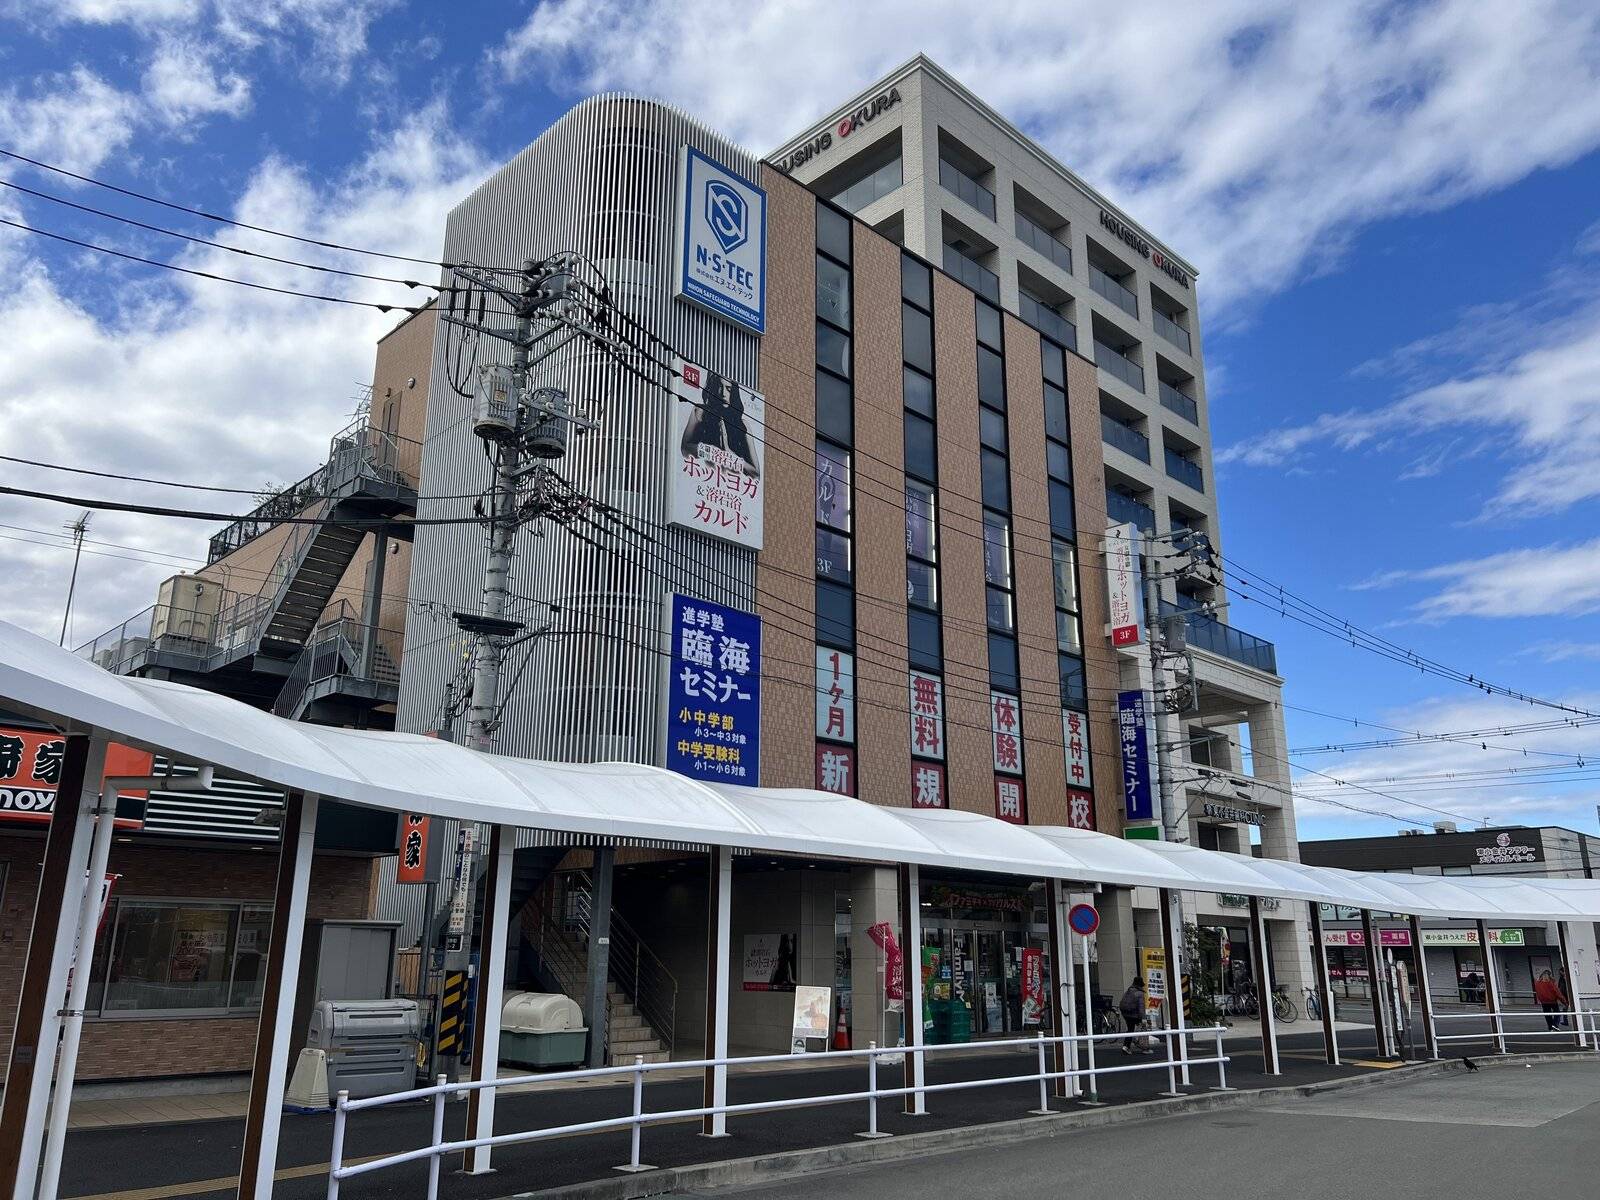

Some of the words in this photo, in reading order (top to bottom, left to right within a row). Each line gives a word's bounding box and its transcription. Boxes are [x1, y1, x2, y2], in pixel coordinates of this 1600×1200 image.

[774, 132, 832, 175] USING
[838, 87, 901, 138] OKURA
[1100, 209, 1151, 259] HOUSING
[1152, 250, 1190, 290] OKURA
[703, 289, 731, 309] SAFEGUARD
[730, 303, 760, 325] TECHNOLOGY
[684, 368, 699, 386] 3F
[683, 456, 760, 499] ホットヨガ
[693, 500, 749, 535] カルド
[816, 557, 833, 574] 3F
[683, 606, 725, 633] 進学塾
[1119, 629, 1131, 640] 3F
[681, 627, 751, 676] 臨海
[680, 666, 751, 703] セミナー
[679, 706, 734, 732] 小中学部
[913, 675, 940, 755] 無料
[994, 696, 1019, 770] 体験
[1067, 712, 1085, 784] 受付中
[677, 739, 741, 765] 中学受験科
[1120, 708, 1140, 812] 臨海セミナー
[820, 751, 849, 793] 新
[916, 767, 942, 806] 規
[998, 781, 1021, 819] 開
[1070, 794, 1091, 829] 校
[1424, 931, 1499, 943] 東小金井うえだ皮科
